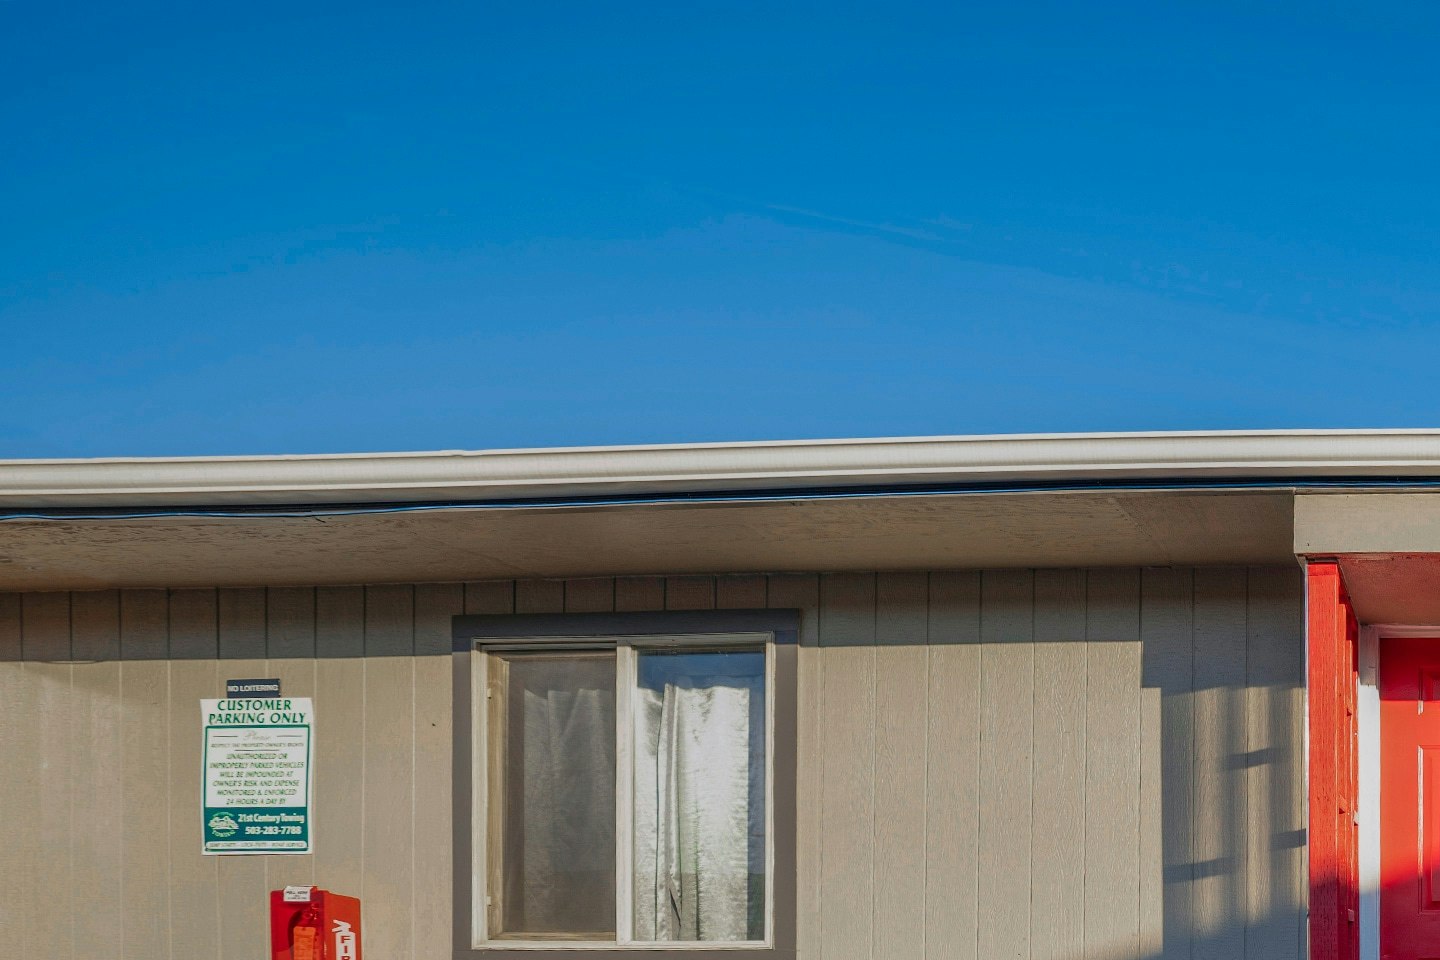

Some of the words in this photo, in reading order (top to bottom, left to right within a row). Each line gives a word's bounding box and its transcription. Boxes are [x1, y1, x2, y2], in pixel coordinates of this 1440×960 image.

[240, 684, 279, 692] LOITERING
[217, 699, 291, 711] CUSTOMER
[208, 713, 265, 725] PARKING
[270, 712, 306, 724] ONLY
[237, 813, 253, 823] 21st
[253, 813, 280, 824] Century
[280, 812, 305, 824] Towing
